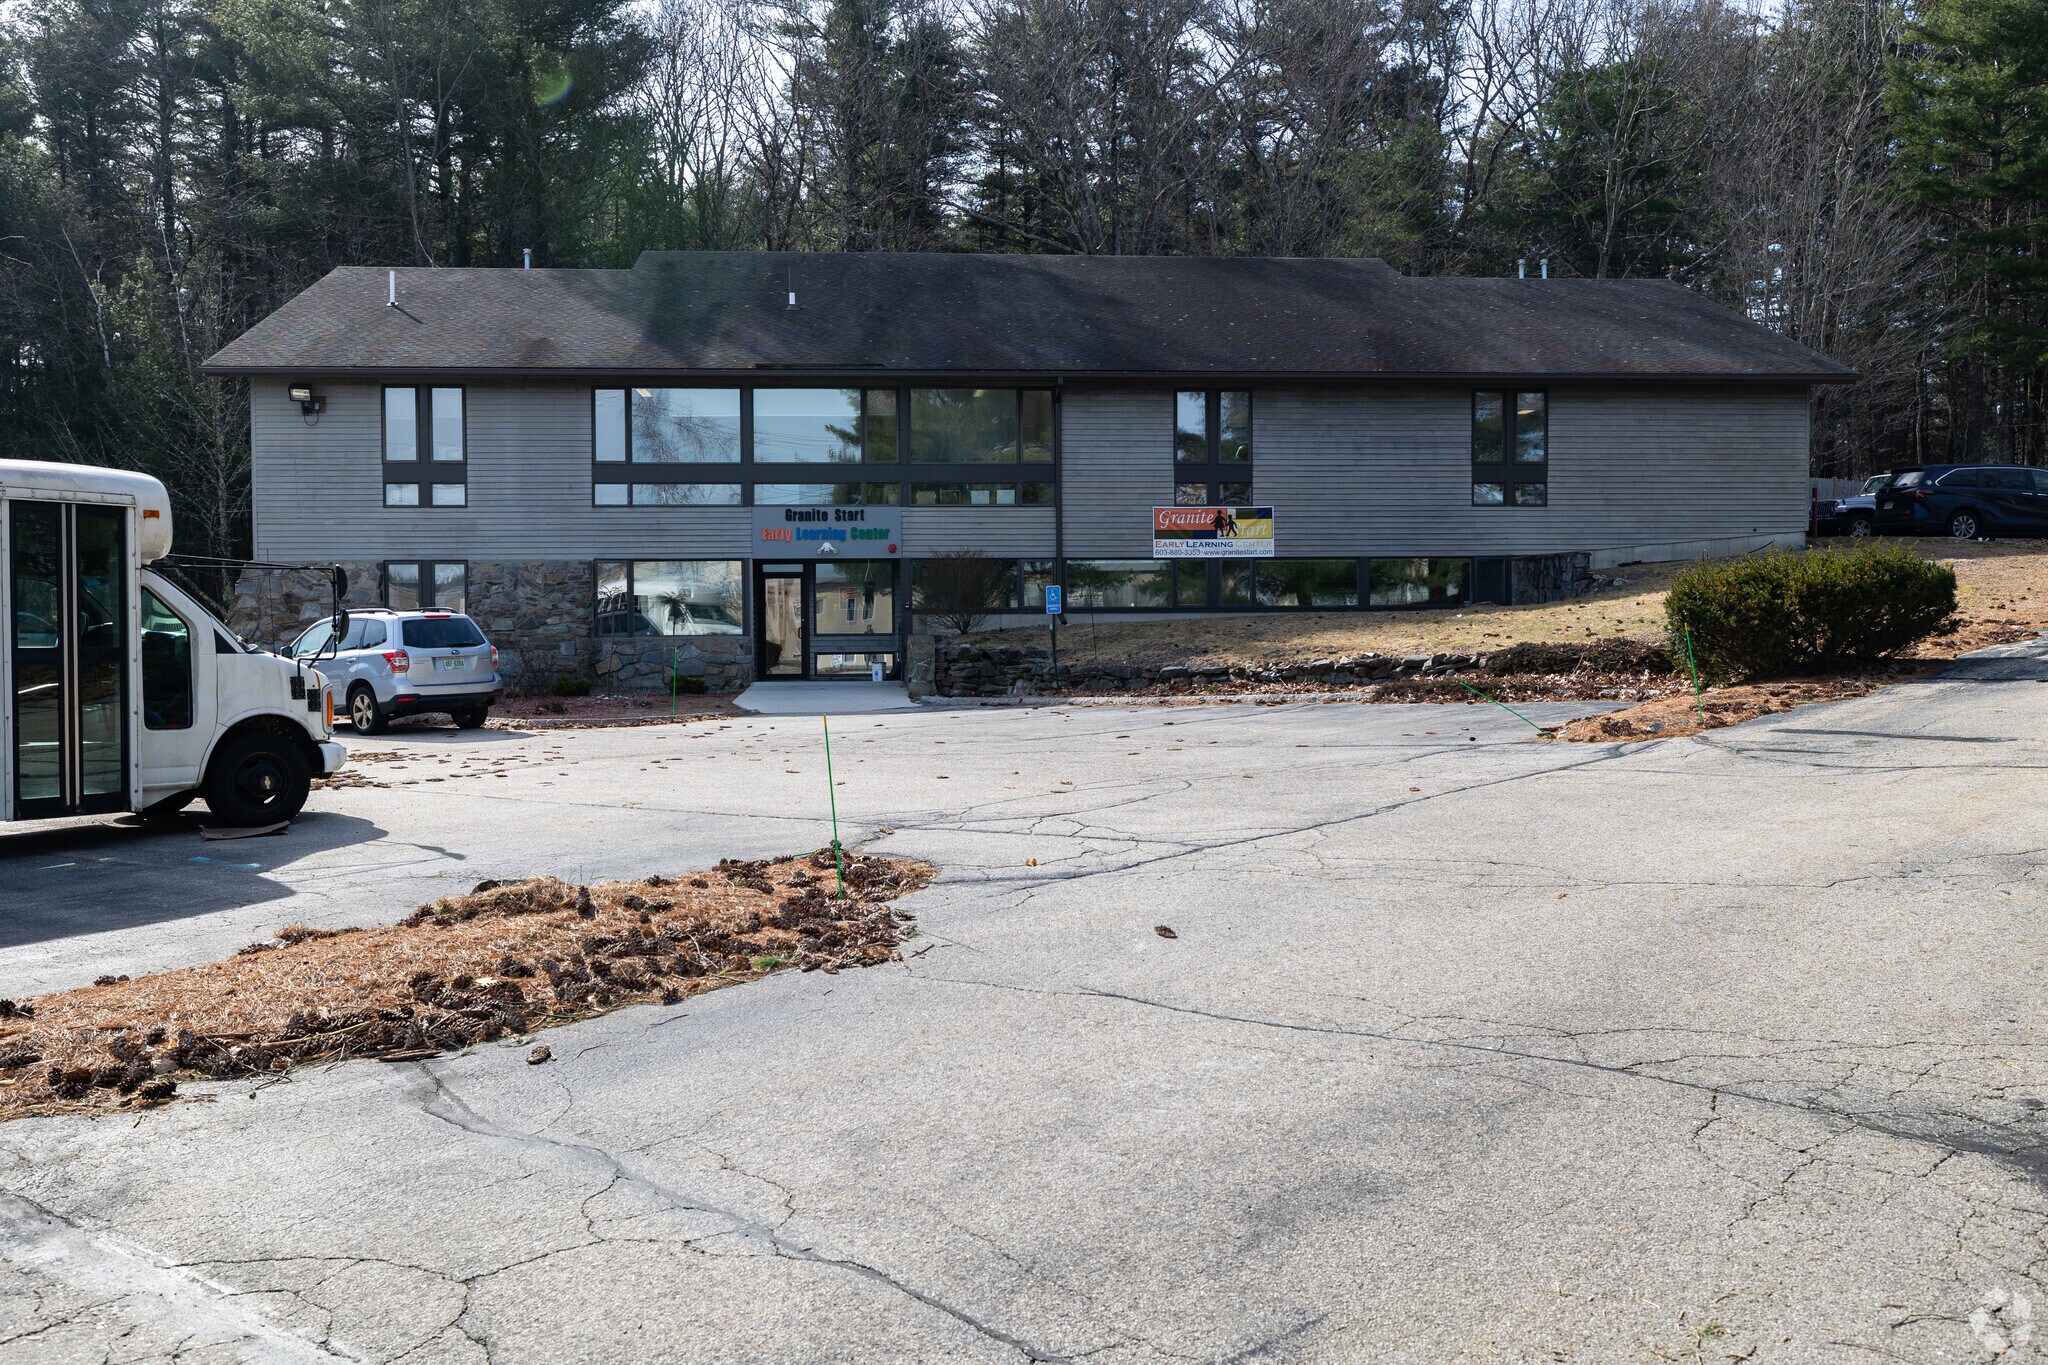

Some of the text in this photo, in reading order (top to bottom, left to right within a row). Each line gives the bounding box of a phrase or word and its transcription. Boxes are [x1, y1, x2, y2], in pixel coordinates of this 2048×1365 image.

[785, 508, 865, 522] Granite Start
[1159, 509, 1214, 529] Granite
[761, 526, 890, 542] Early Learning Center
[1155, 540, 1185, 548] EARLY
[1186, 540, 1234, 548] LEARNING
[1204, 548, 1273, 556] www.granitestart.com
